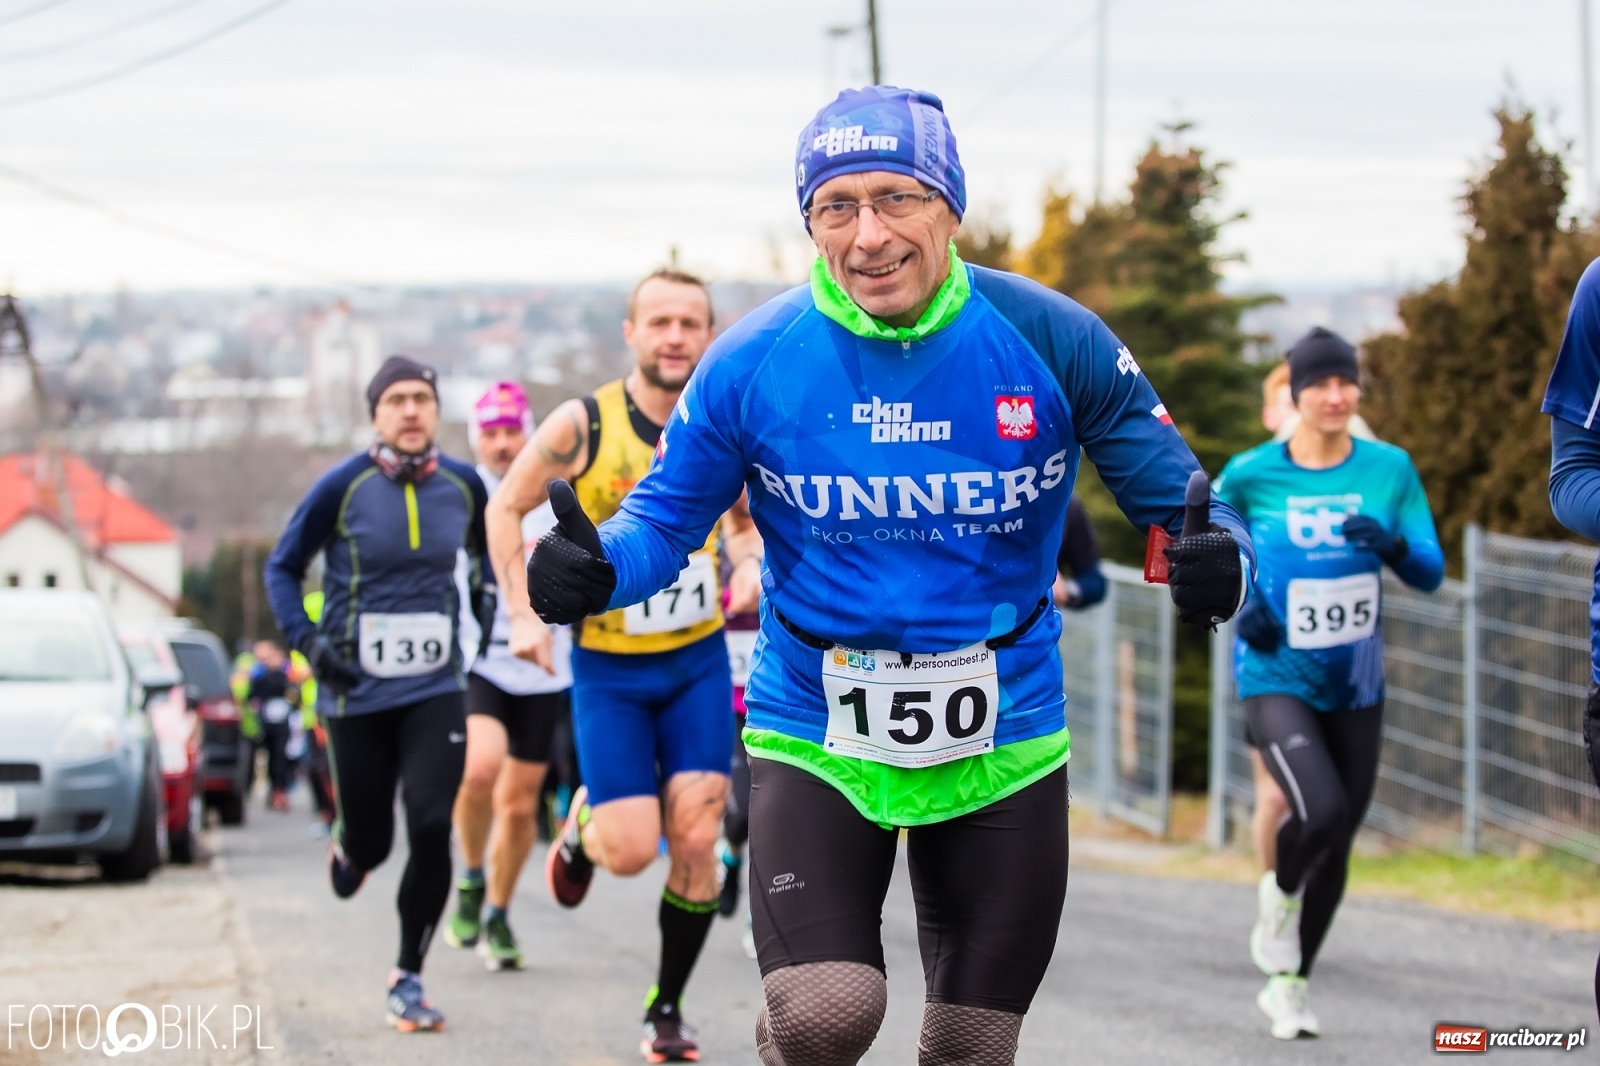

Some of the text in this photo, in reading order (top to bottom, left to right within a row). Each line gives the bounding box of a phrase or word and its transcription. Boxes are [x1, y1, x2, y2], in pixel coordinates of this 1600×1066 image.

[994, 384, 1033, 392] POLAND
[852, 396, 913, 424] eko
[871, 420, 951, 443] okna
[752, 449, 1067, 520] RUNNERS
[953, 518, 1024, 538] TEAM
[643, 581, 706, 618] 171
[1299, 600, 1371, 633] 395
[369, 638, 443, 664] 139
[838, 686, 988, 745] 150
